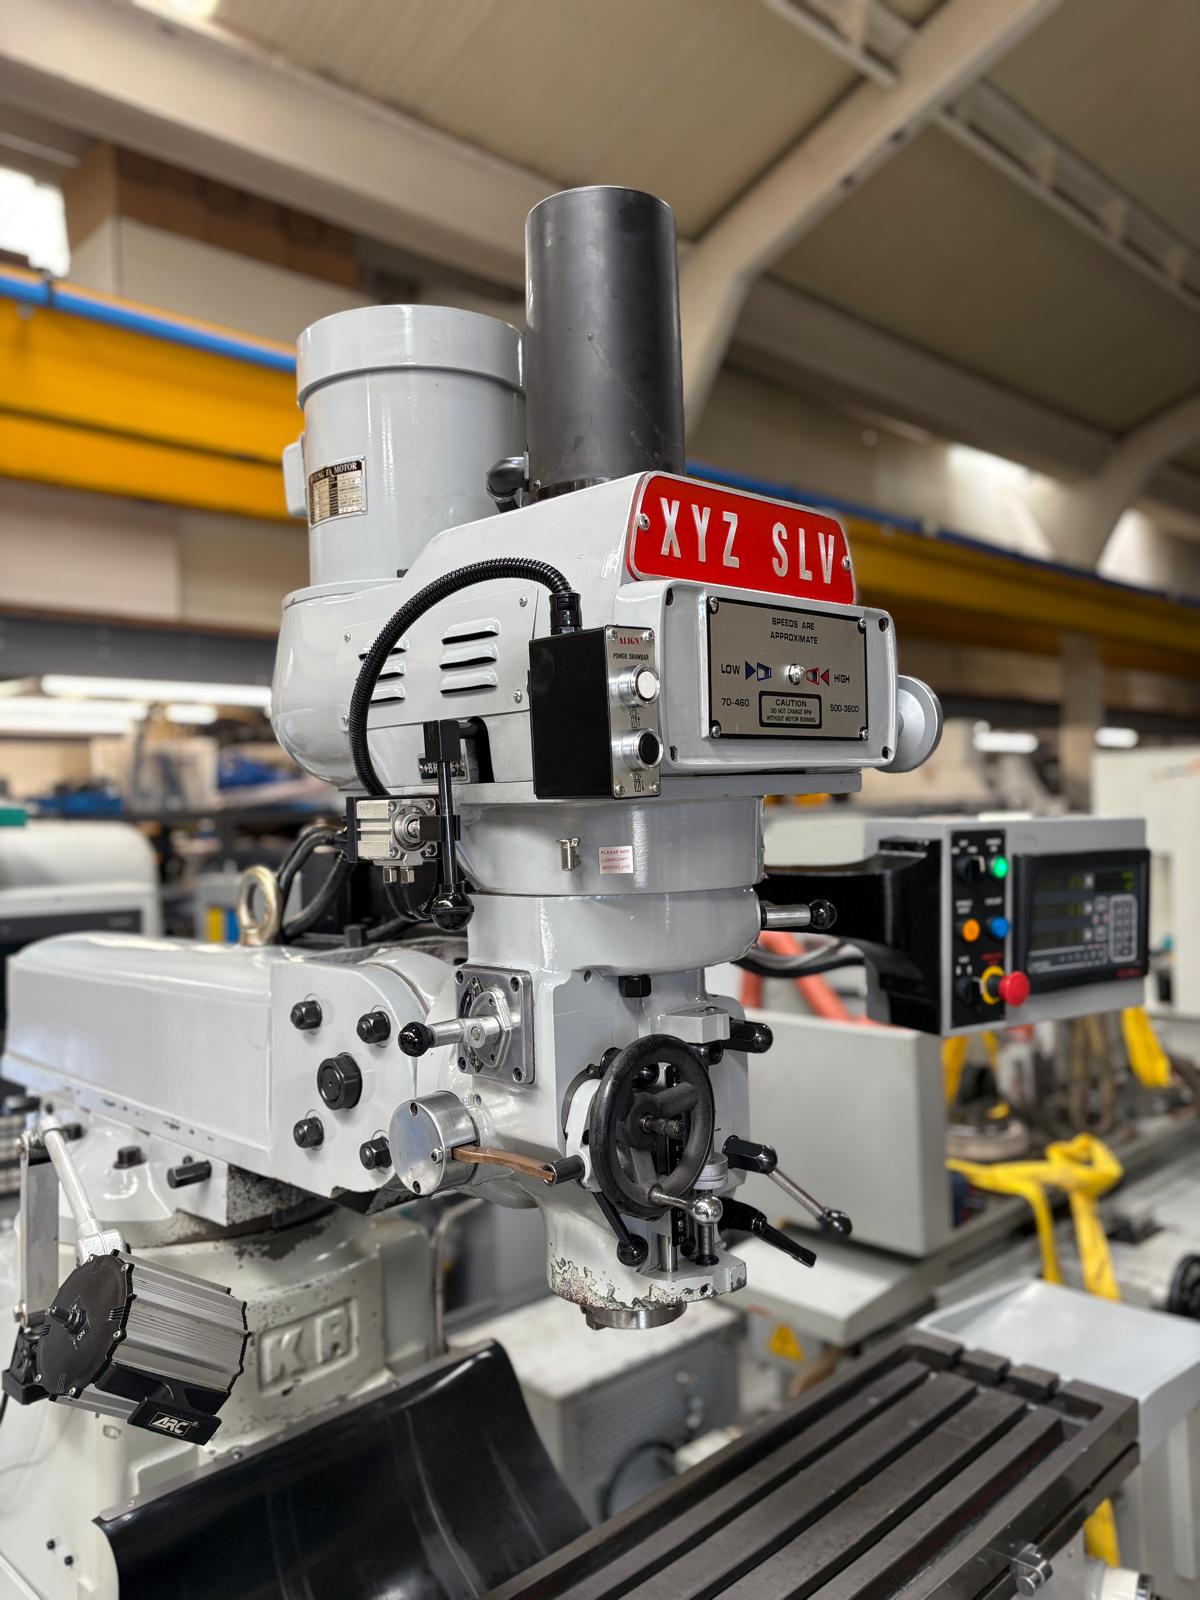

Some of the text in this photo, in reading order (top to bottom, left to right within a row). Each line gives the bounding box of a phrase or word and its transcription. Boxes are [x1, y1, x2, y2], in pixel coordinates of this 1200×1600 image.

[334, 463, 358, 474] MOTOR
[659, 497, 835, 585] XYZ SLV
[771, 617, 815, 631] SPEEDS ARE
[619, 636, 639, 645] ALIGN
[769, 631, 818, 645] APPROXIMATE
[613, 652, 649, 661] POWER DRAWBAR
[720, 663, 741, 675] LOW
[833, 673, 850, 684] HIGH
[721, 697, 750, 708] 70-460
[775, 698, 807, 708] CAUTION
[262, 1305, 351, 1387] KR
[151, 1416, 189, 1434] ARC
